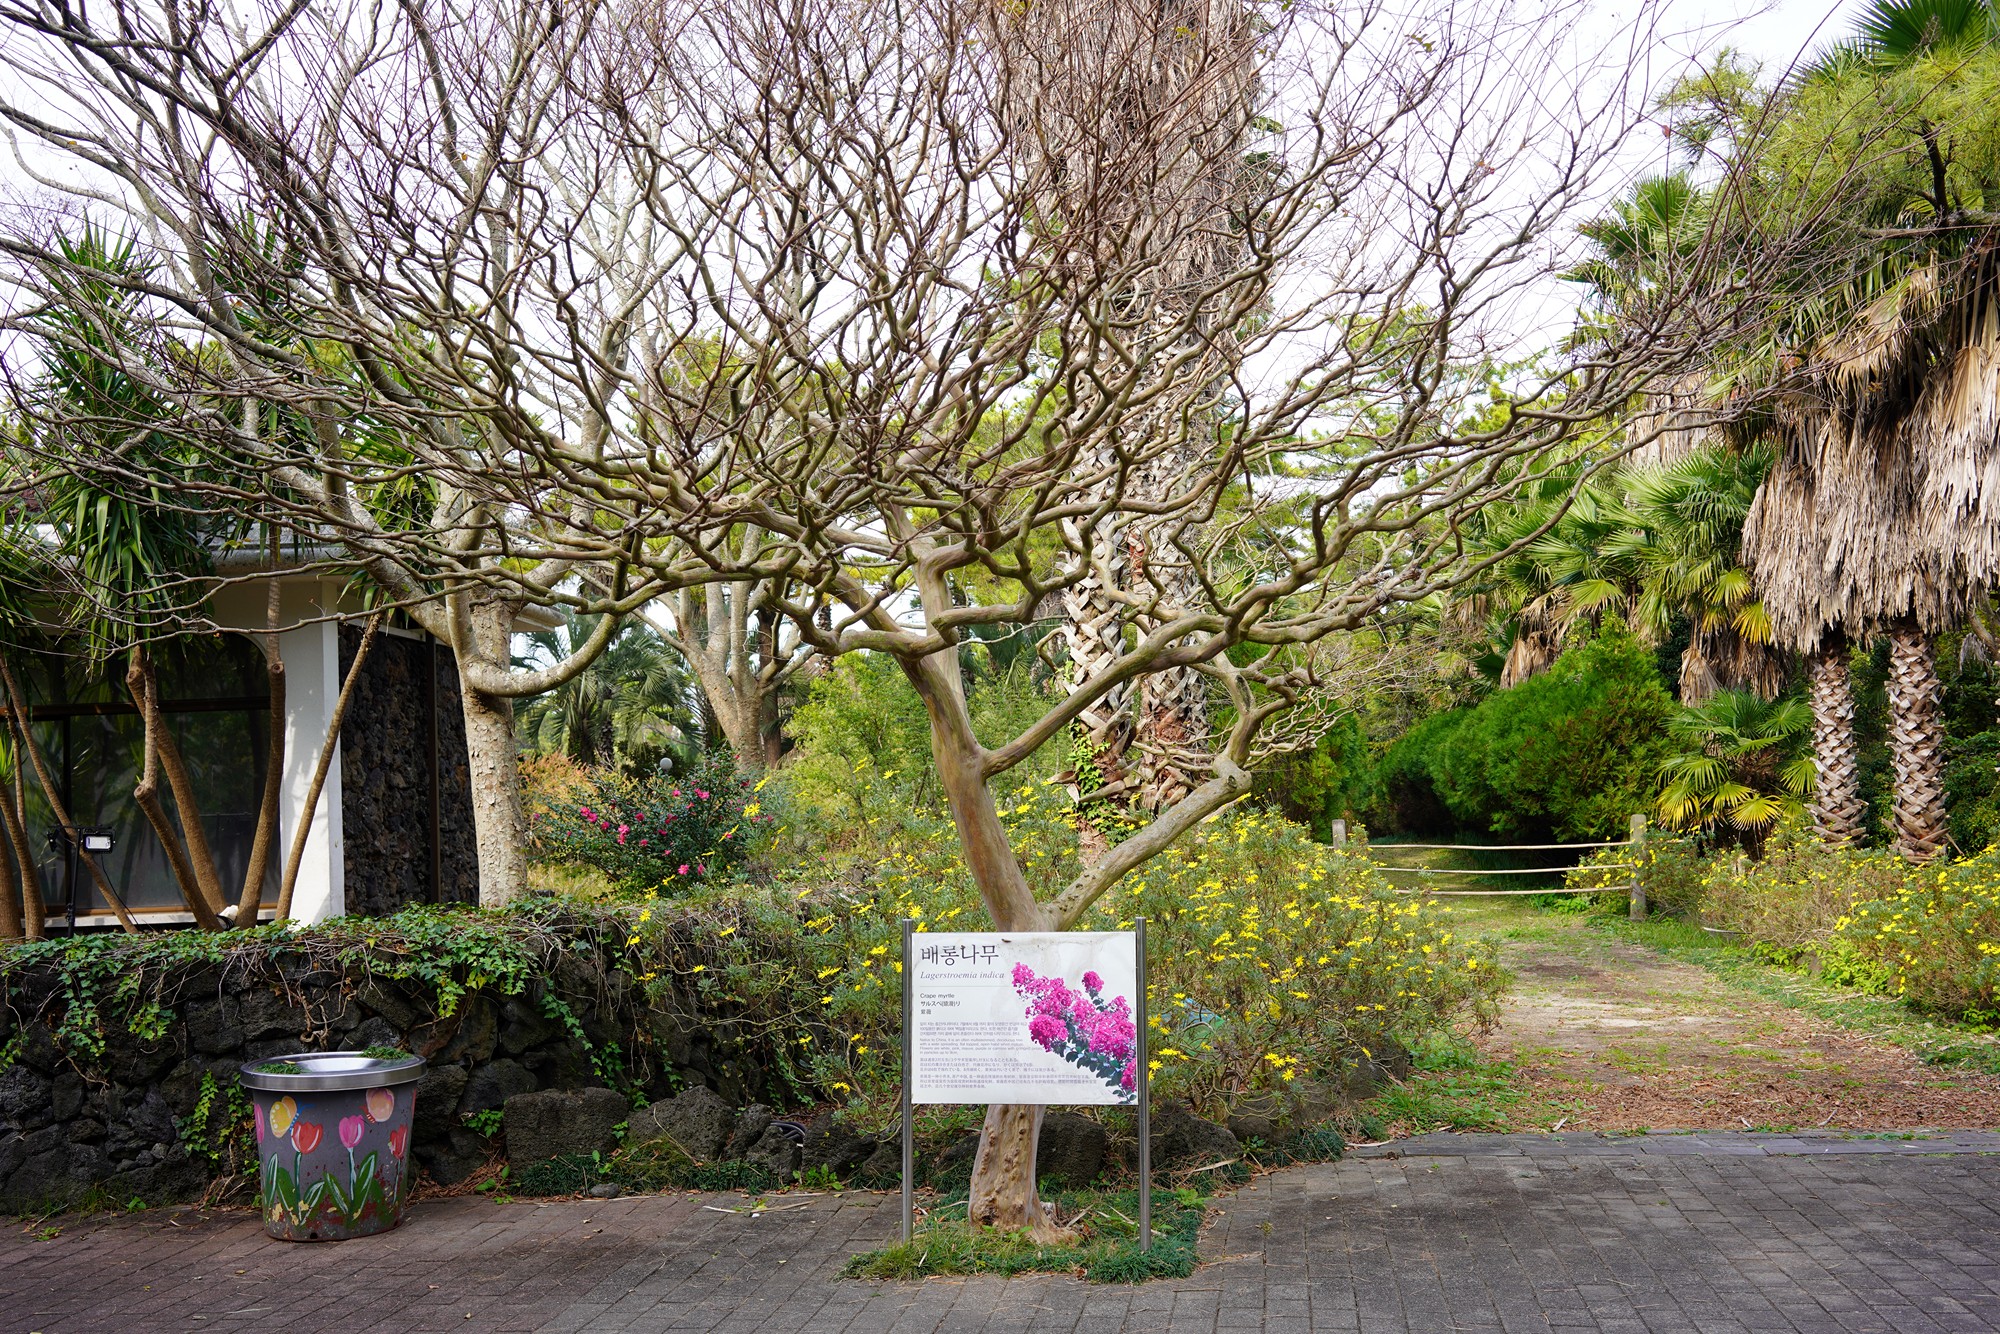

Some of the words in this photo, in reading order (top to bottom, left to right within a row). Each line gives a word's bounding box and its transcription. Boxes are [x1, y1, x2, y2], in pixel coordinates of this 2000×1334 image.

[920, 944, 999, 966] 배롱나무
[920, 971, 977, 980] Lagerstroemia
[979, 971, 1005, 979] indica
